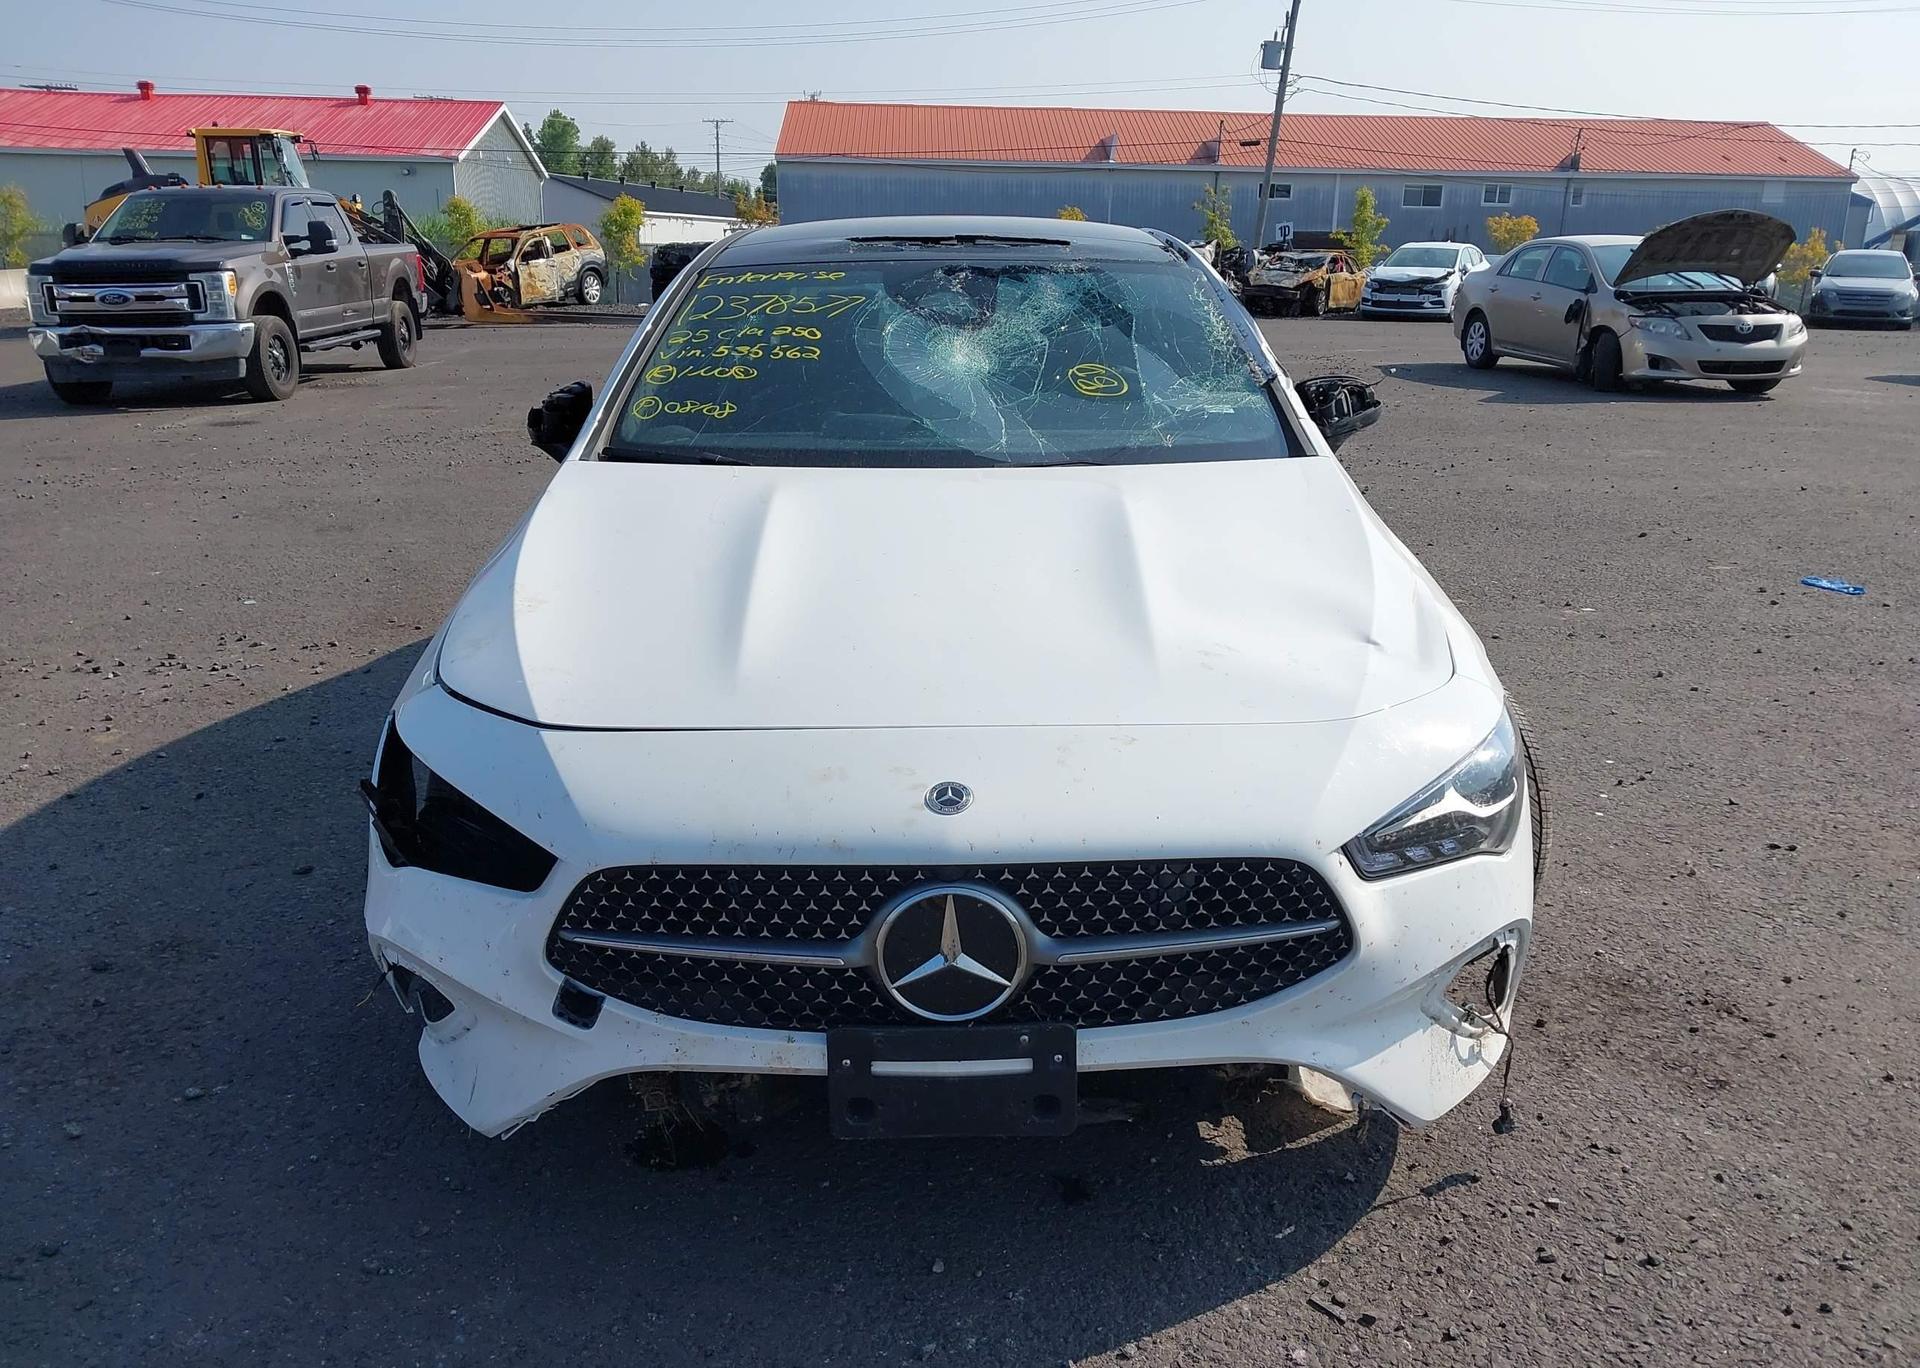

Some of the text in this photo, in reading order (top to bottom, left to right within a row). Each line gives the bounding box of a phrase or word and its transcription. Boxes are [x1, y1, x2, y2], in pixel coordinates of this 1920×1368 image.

[677, 294, 866, 326] 12378577
[668, 330, 711, 344] 25
[771, 325, 822, 340] 250
